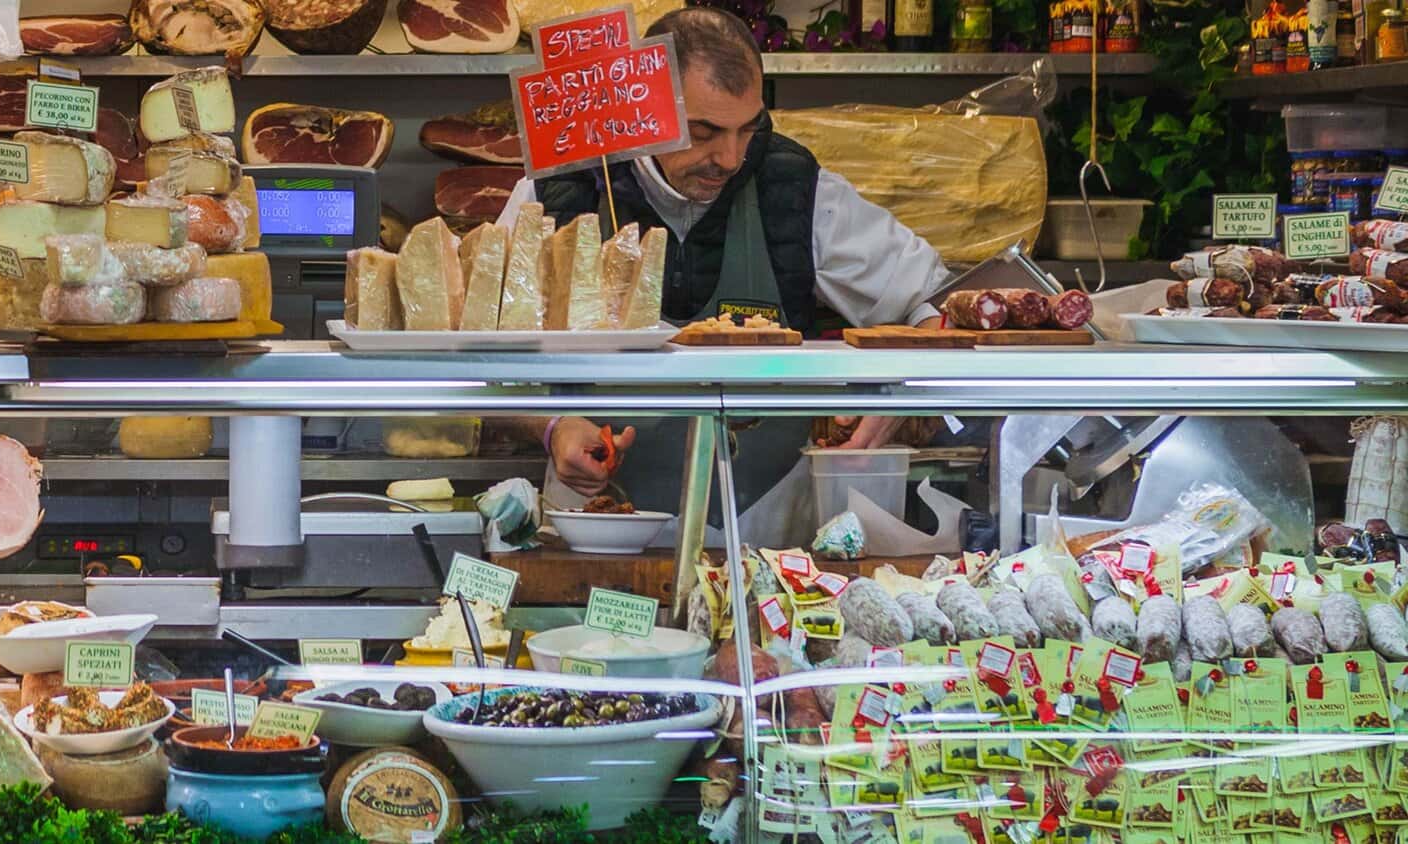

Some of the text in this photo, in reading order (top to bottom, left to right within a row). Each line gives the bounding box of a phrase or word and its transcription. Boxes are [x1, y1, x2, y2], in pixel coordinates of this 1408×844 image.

[35, 92, 91, 104] PECORINO CON
[33, 100, 59, 109] FARRO
[67, 103, 91, 113] BIRRA
[1219, 201, 1270, 210] SALAME AL
[1223, 213, 1266, 221] TARTUFO
[1292, 218, 1343, 231] SALAME di
[1291, 230, 1344, 242] CINGHIALE
[595, 596, 652, 613] MOZZARELLA
[80, 647, 120, 657] CAPRINI
[312, 648, 338, 656] SALSA
[78, 659, 122, 670] SPEZIATI
[1132, 703, 1175, 714] SALAMINO
[1303, 703, 1345, 712] SALAMINO
